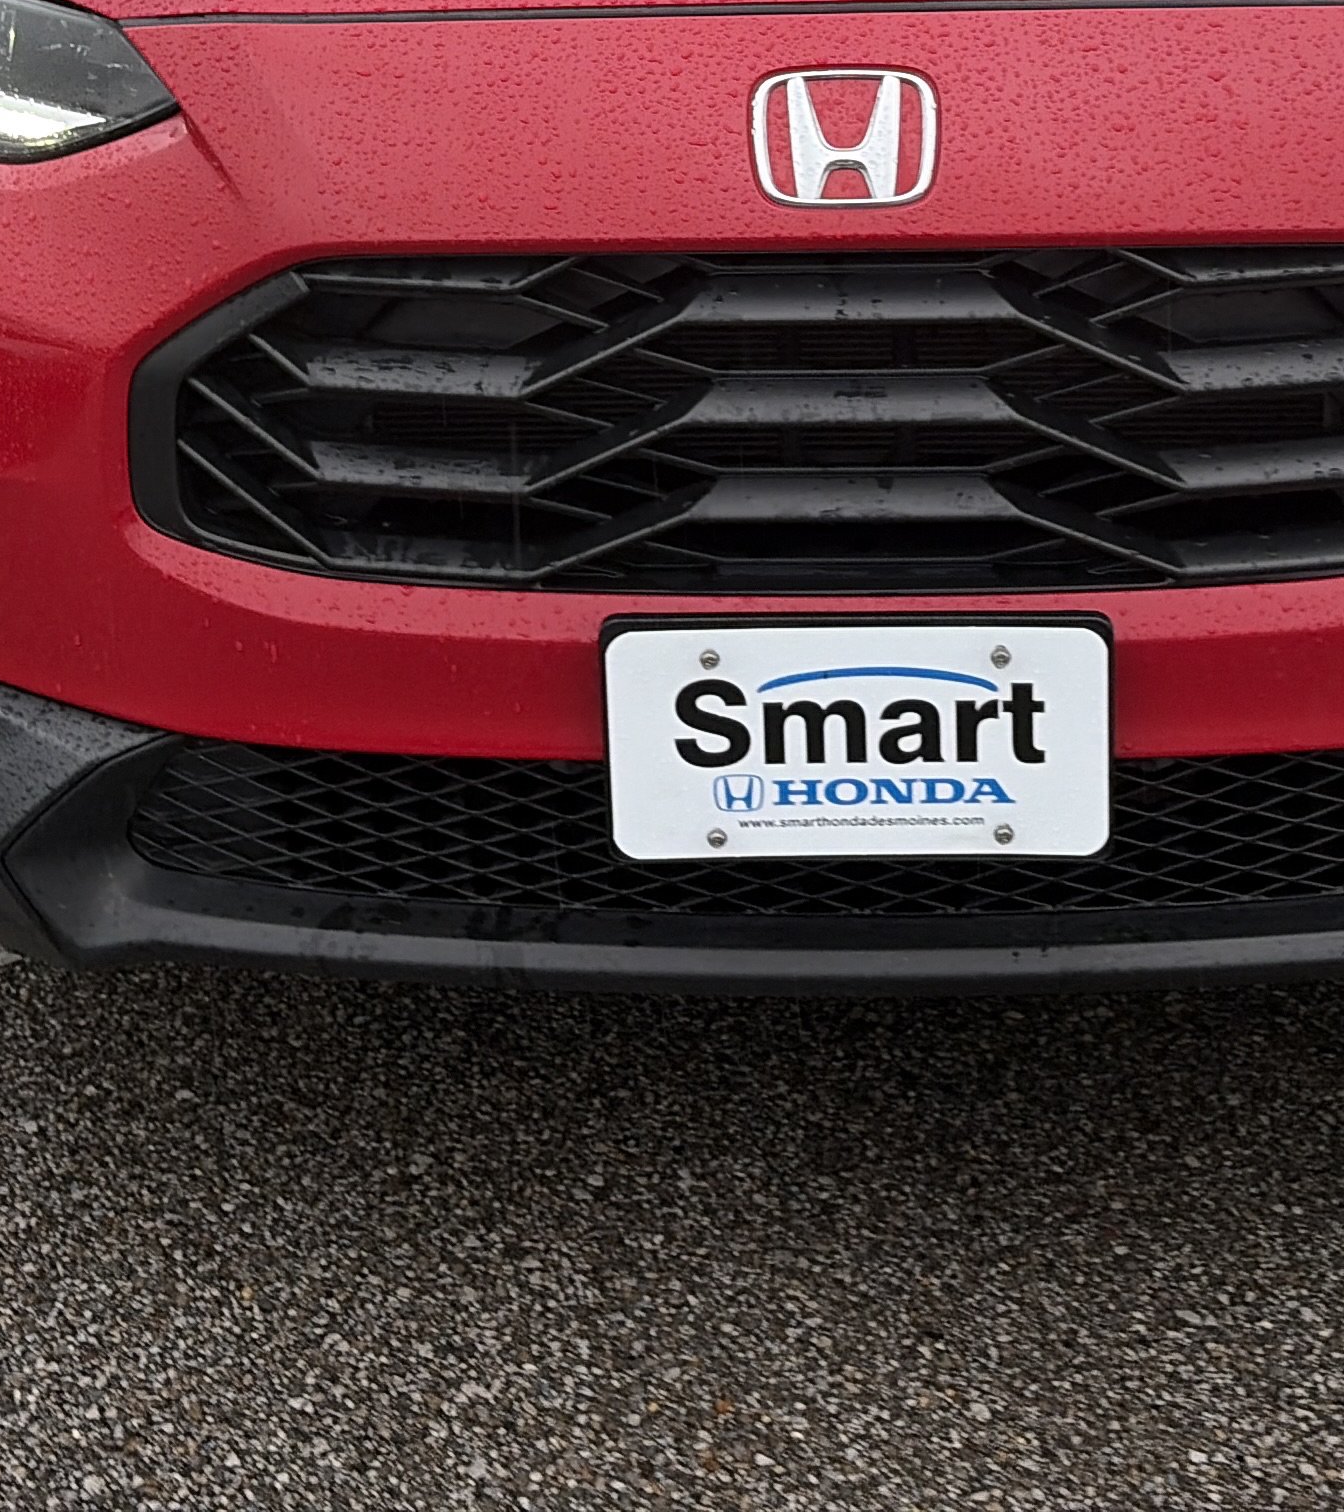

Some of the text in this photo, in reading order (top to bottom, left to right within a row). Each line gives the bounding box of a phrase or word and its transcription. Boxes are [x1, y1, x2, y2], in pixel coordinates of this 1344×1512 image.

[674, 678, 1046, 768] Smart
[772, 778, 1016, 806] HONDA
[738, 815, 985, 828] www.smarthondadesmoines.com
